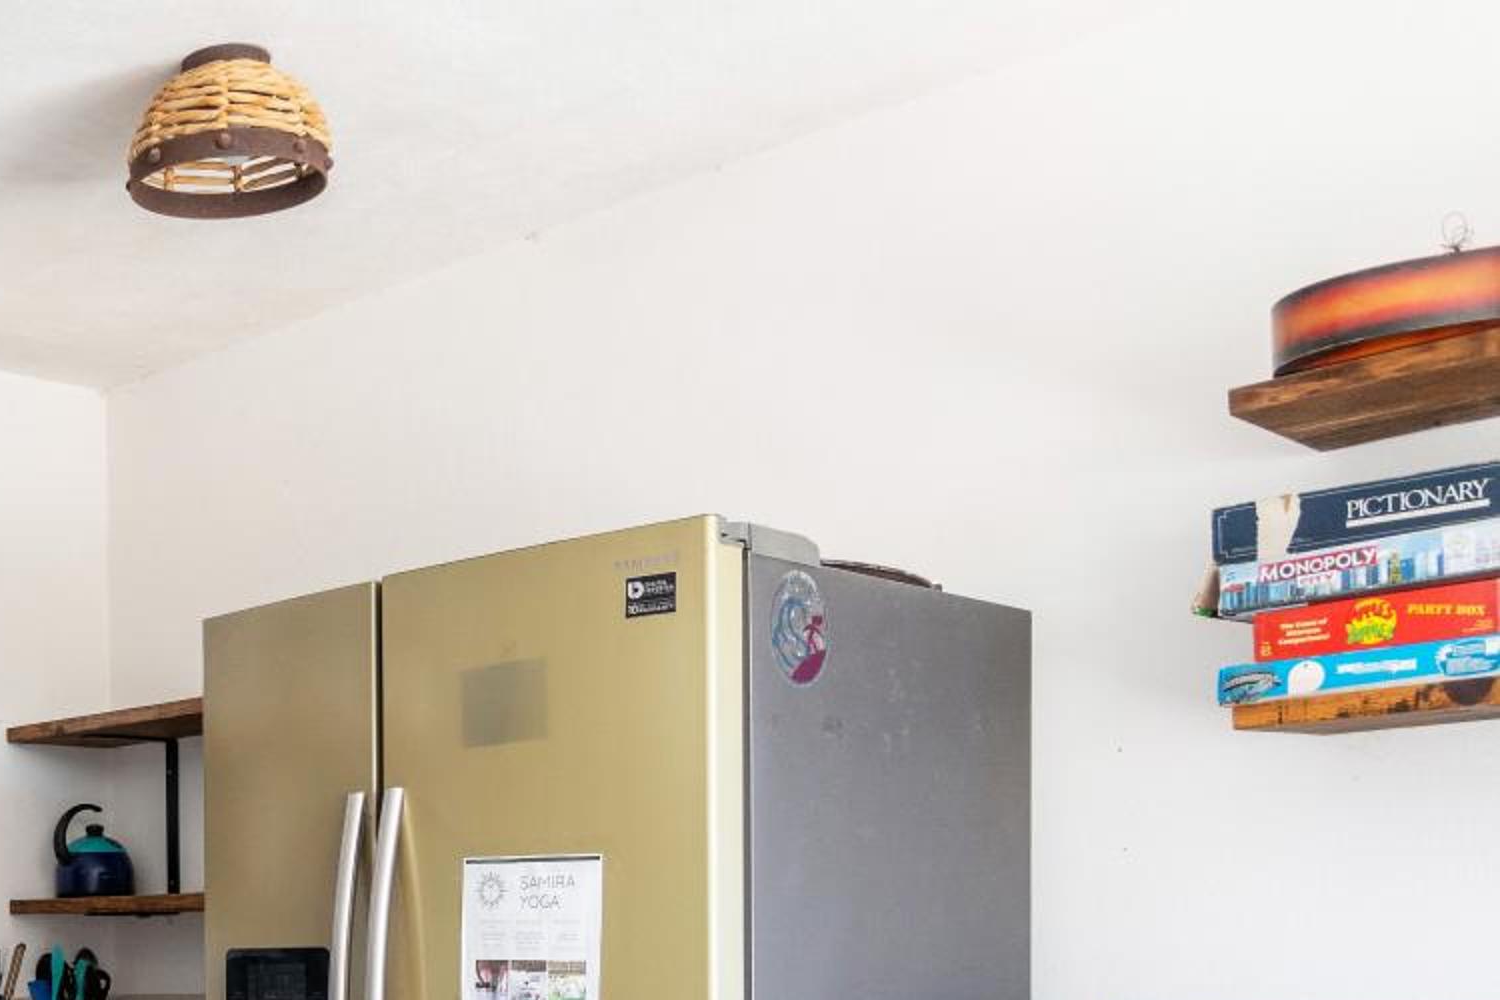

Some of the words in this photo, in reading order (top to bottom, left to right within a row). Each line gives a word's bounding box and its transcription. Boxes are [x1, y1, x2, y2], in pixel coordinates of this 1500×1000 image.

[1346, 478, 1490, 519] PICTIONARY
[1259, 547, 1377, 583] MONOPOLY
[519, 874, 576, 891] SAMIRA
[519, 894, 561, 910] YOGA
